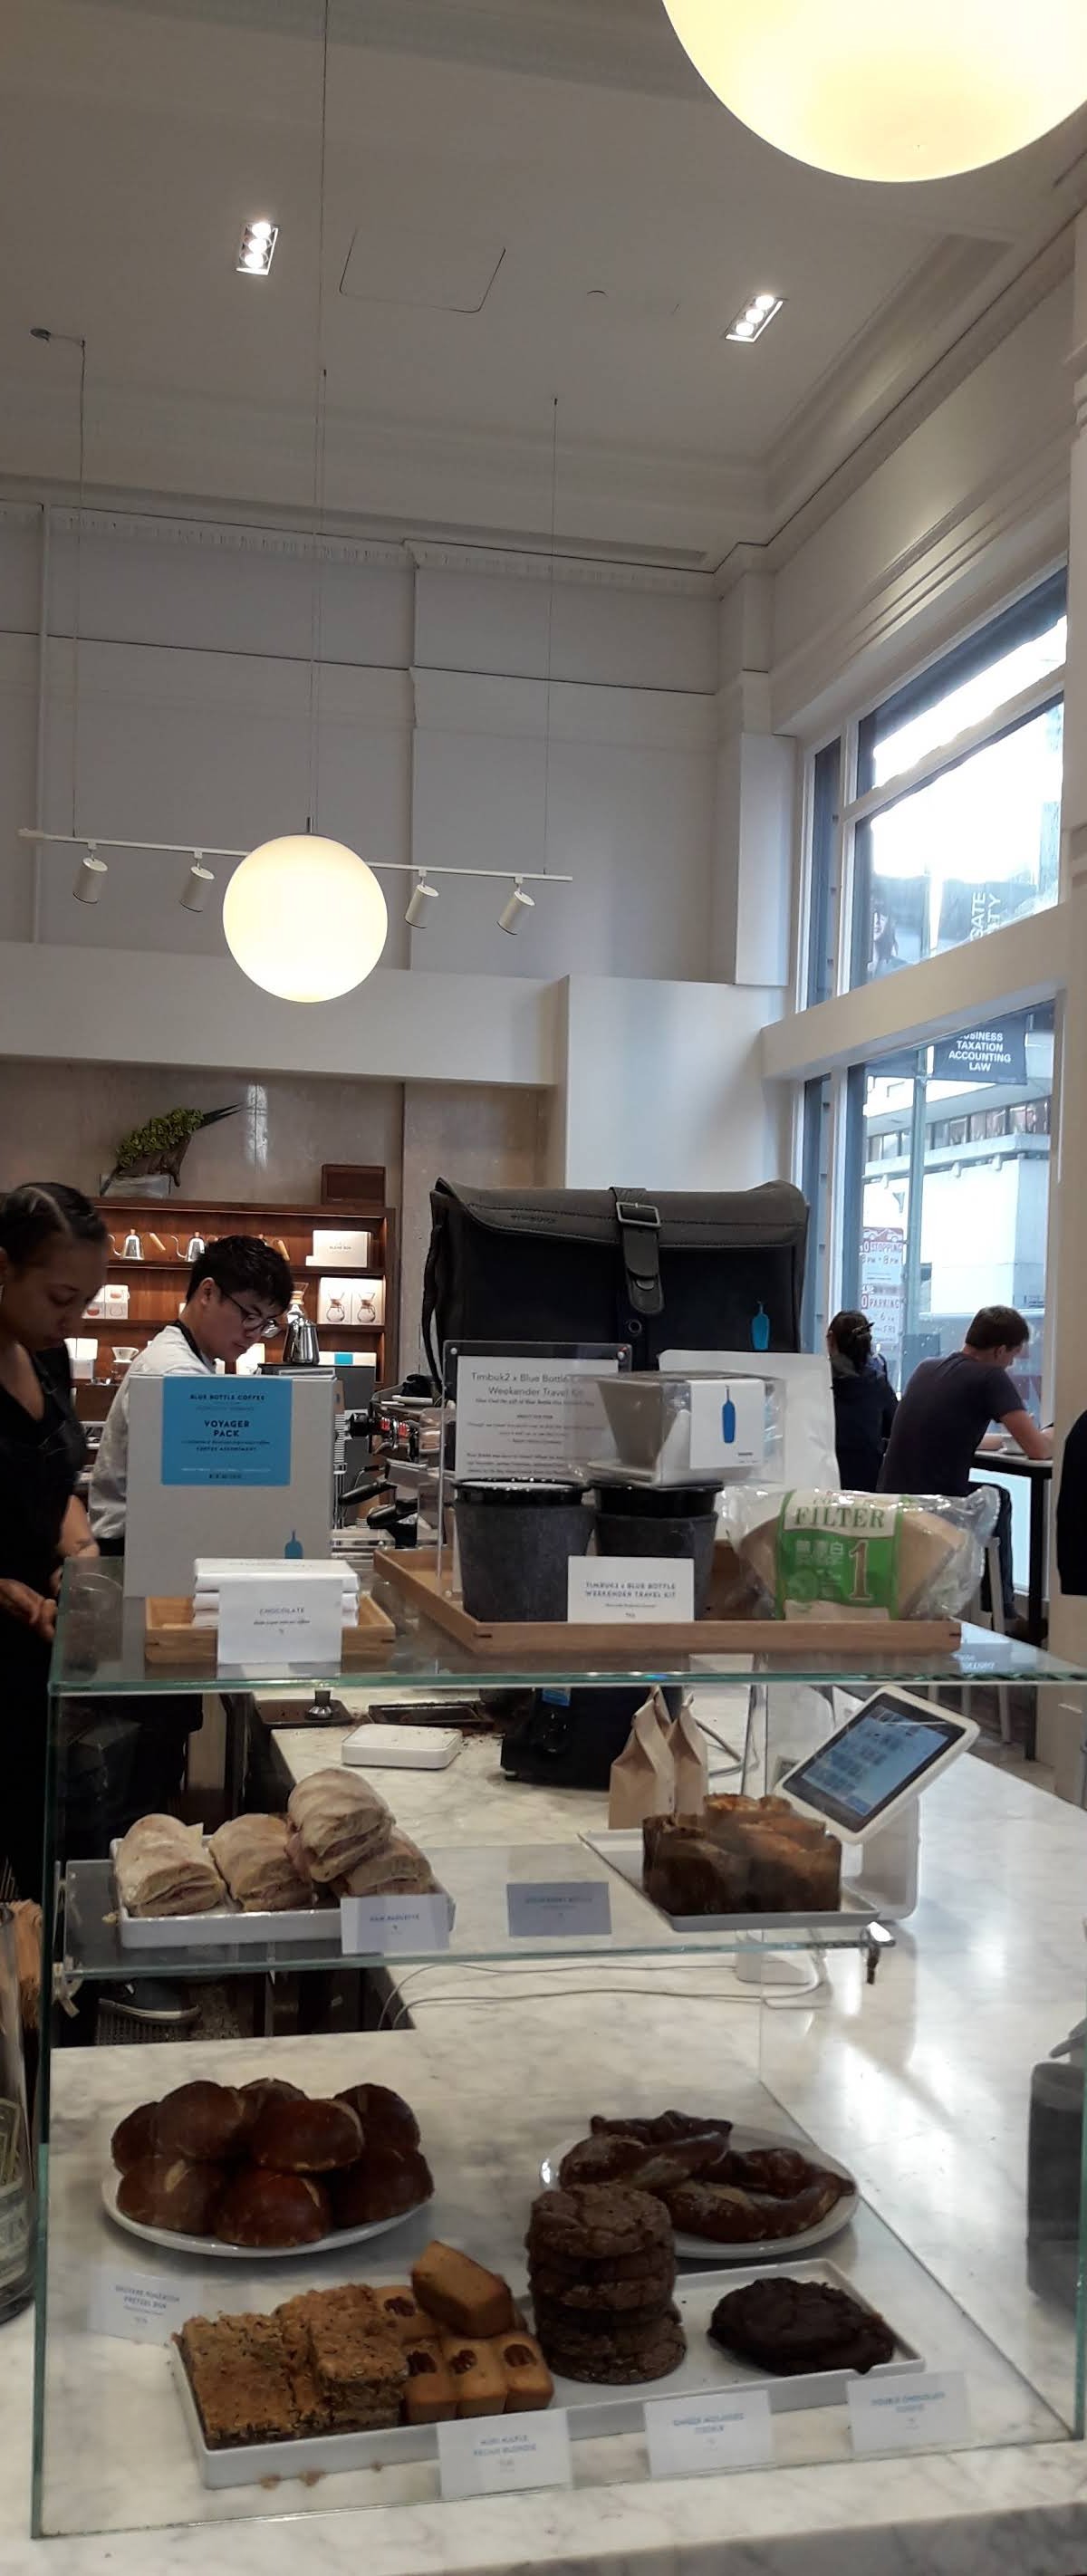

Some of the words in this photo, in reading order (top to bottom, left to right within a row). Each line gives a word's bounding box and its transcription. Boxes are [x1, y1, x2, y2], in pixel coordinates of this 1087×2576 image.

[956, 1040, 1004, 1053] TAXATION
[948, 1050, 1012, 1063] ACCOUNTING
[968, 1062, 992, 1072] LAW
[869, 1297, 899, 1310] PARKING
[471, 1372, 510, 1382] Timbuk2
[520, 1373, 540, 1382] Blue
[542, 1374, 567, 1384] Bottle
[487, 1386, 540, 1397] Weekender
[544, 1387, 569, 1398] Travel
[204, 1419, 250, 1428] VOYAGER
[213, 1429, 240, 1437] PACK
[794, 1505, 885, 1529] FILTER
[848, 1539, 873, 1601] 1
[626, 1581, 645, 1590] BLUE
[647, 1581, 676, 1590] BOTTLE
[585, 1590, 632, 1598] WEEKENDER
[634, 1591, 661, 1599] TRAVEL
[663, 1591, 676, 1599] KIT
[259, 1607, 305, 1615] CHOCOLATE
[123, 2295, 151, 2307] PRETZEL
